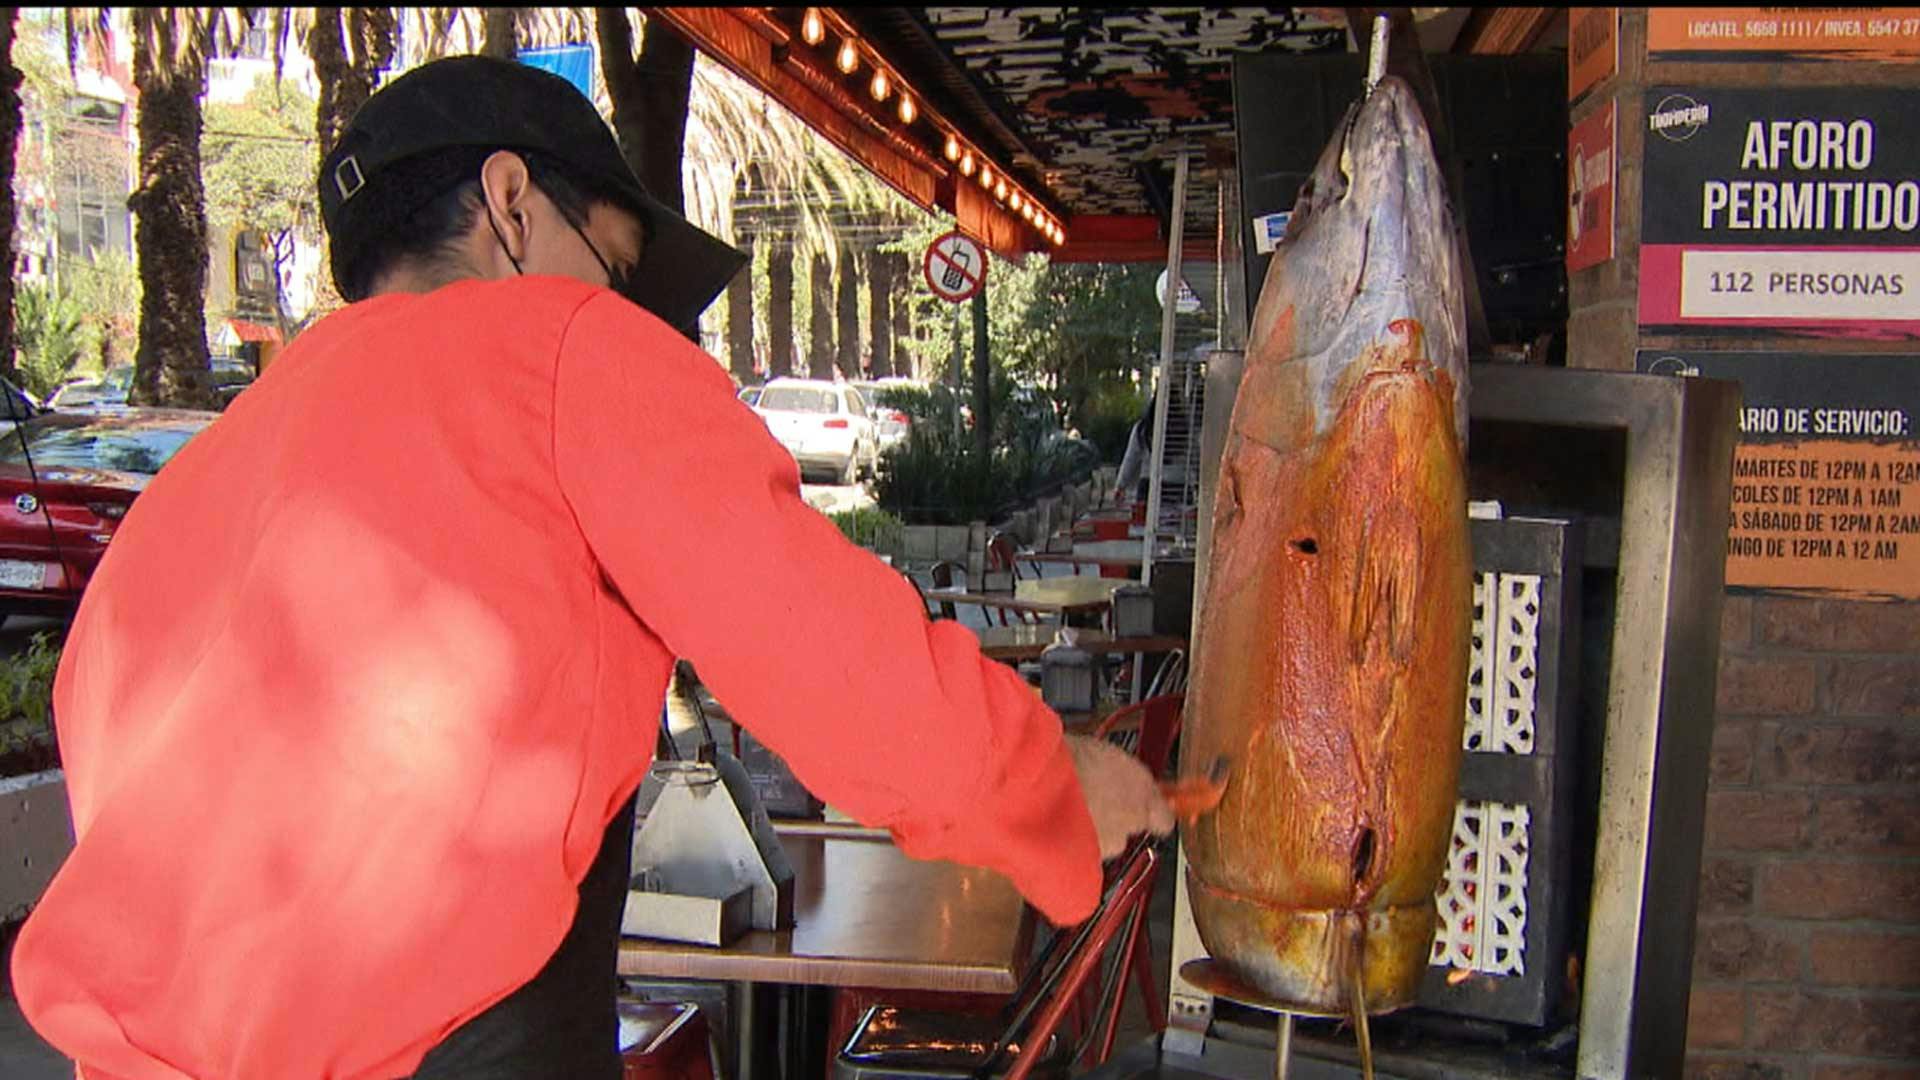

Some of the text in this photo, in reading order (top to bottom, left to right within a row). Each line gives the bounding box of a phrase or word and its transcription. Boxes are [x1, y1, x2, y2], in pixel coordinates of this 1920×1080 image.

[1741, 120, 1875, 170] AFORO
[1702, 181, 1920, 231] PERMITIDO
[1710, 271, 1904, 295] 112 PERSONAS
[1784, 408, 1808, 433] DE
[1814, 409, 1910, 436] SERVICIO:
[1735, 459, 1796, 479] MARTES
[1800, 460, 1819, 479] DE
[1825, 461, 1866, 481] 12PM
[1870, 462, 1881, 481] A
[1732, 485, 1902, 508] COLES DE 12PM A 1AM
[1742, 507, 1801, 531] SÁBADO
[1805, 513, 1824, 532] DE
[1831, 514, 1872, 533] 12PM
[1875, 514, 1886, 533] A
[1766, 538, 1785, 557] DE
[1792, 539, 1832, 558] 12PM
[1836, 540, 1846, 559] A
[1852, 540, 1870, 560] 12
[1874, 541, 1899, 560] AM
